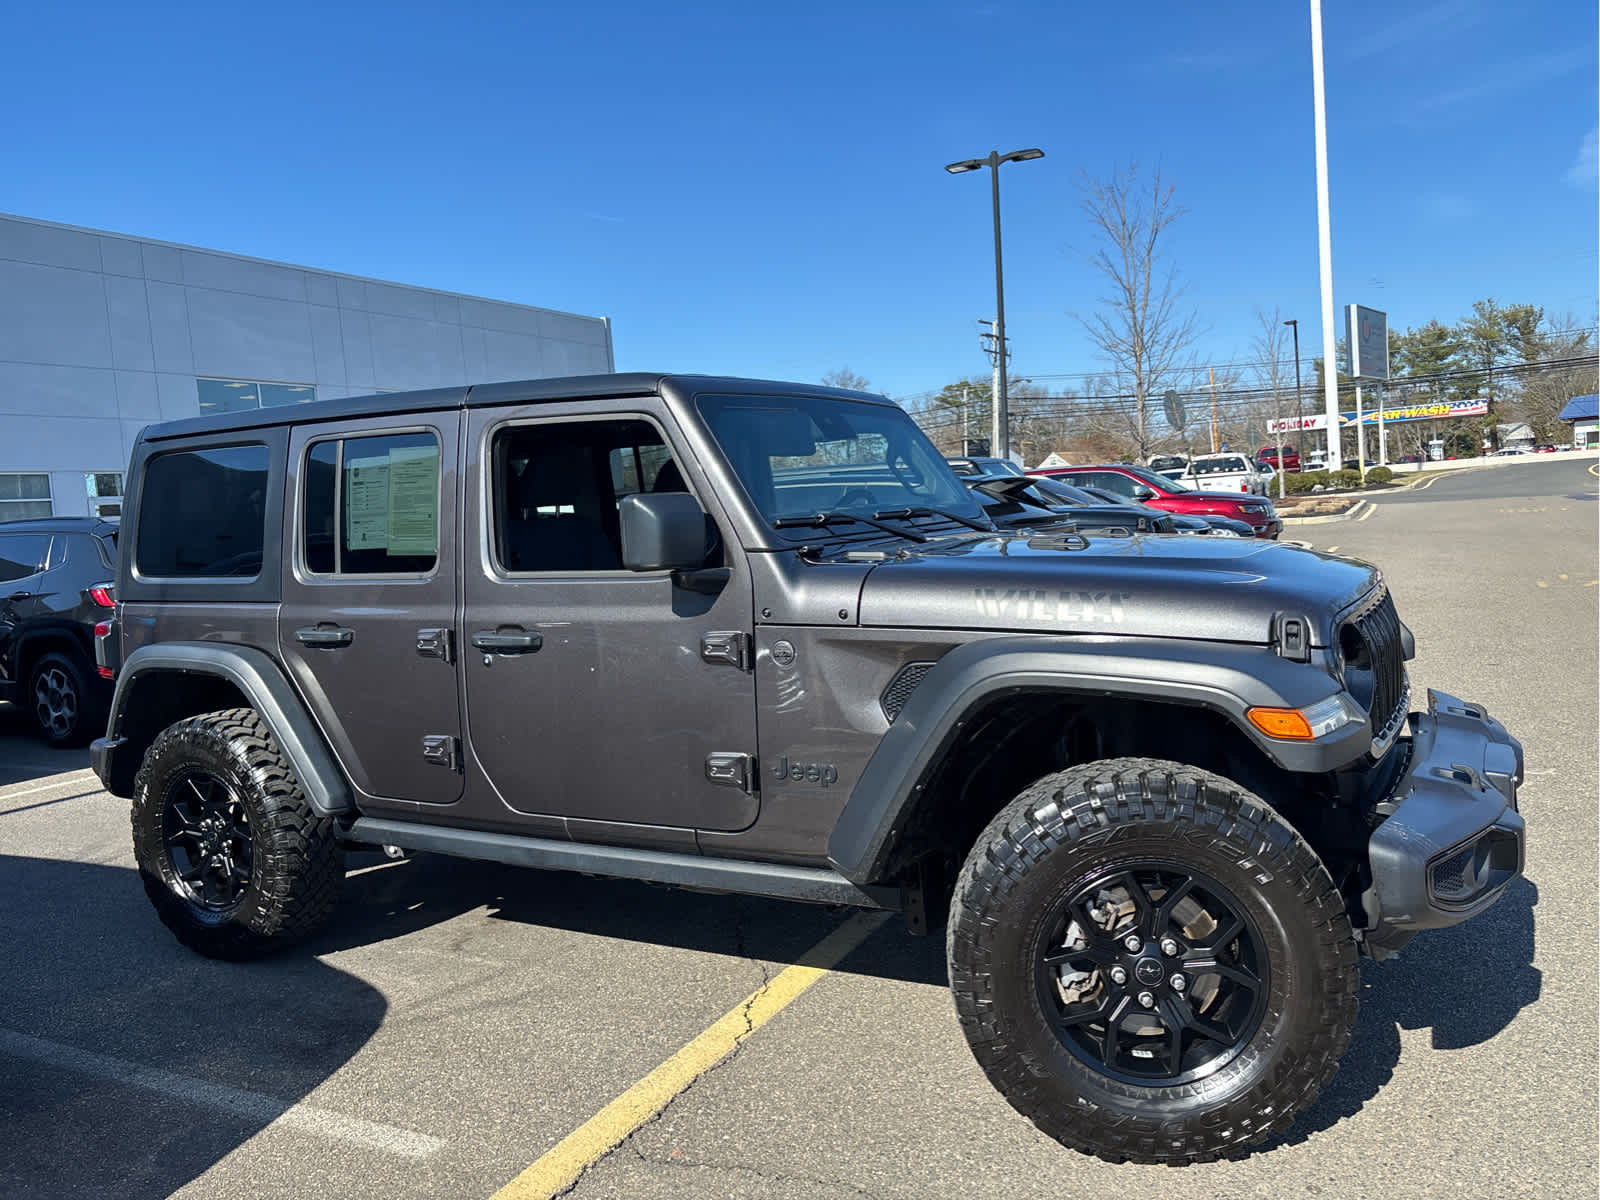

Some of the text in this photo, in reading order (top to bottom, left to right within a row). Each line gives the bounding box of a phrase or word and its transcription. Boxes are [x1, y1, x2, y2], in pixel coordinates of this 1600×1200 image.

[1369, 404, 1451, 421] CAR WASH
[770, 755, 839, 788] Jeep
